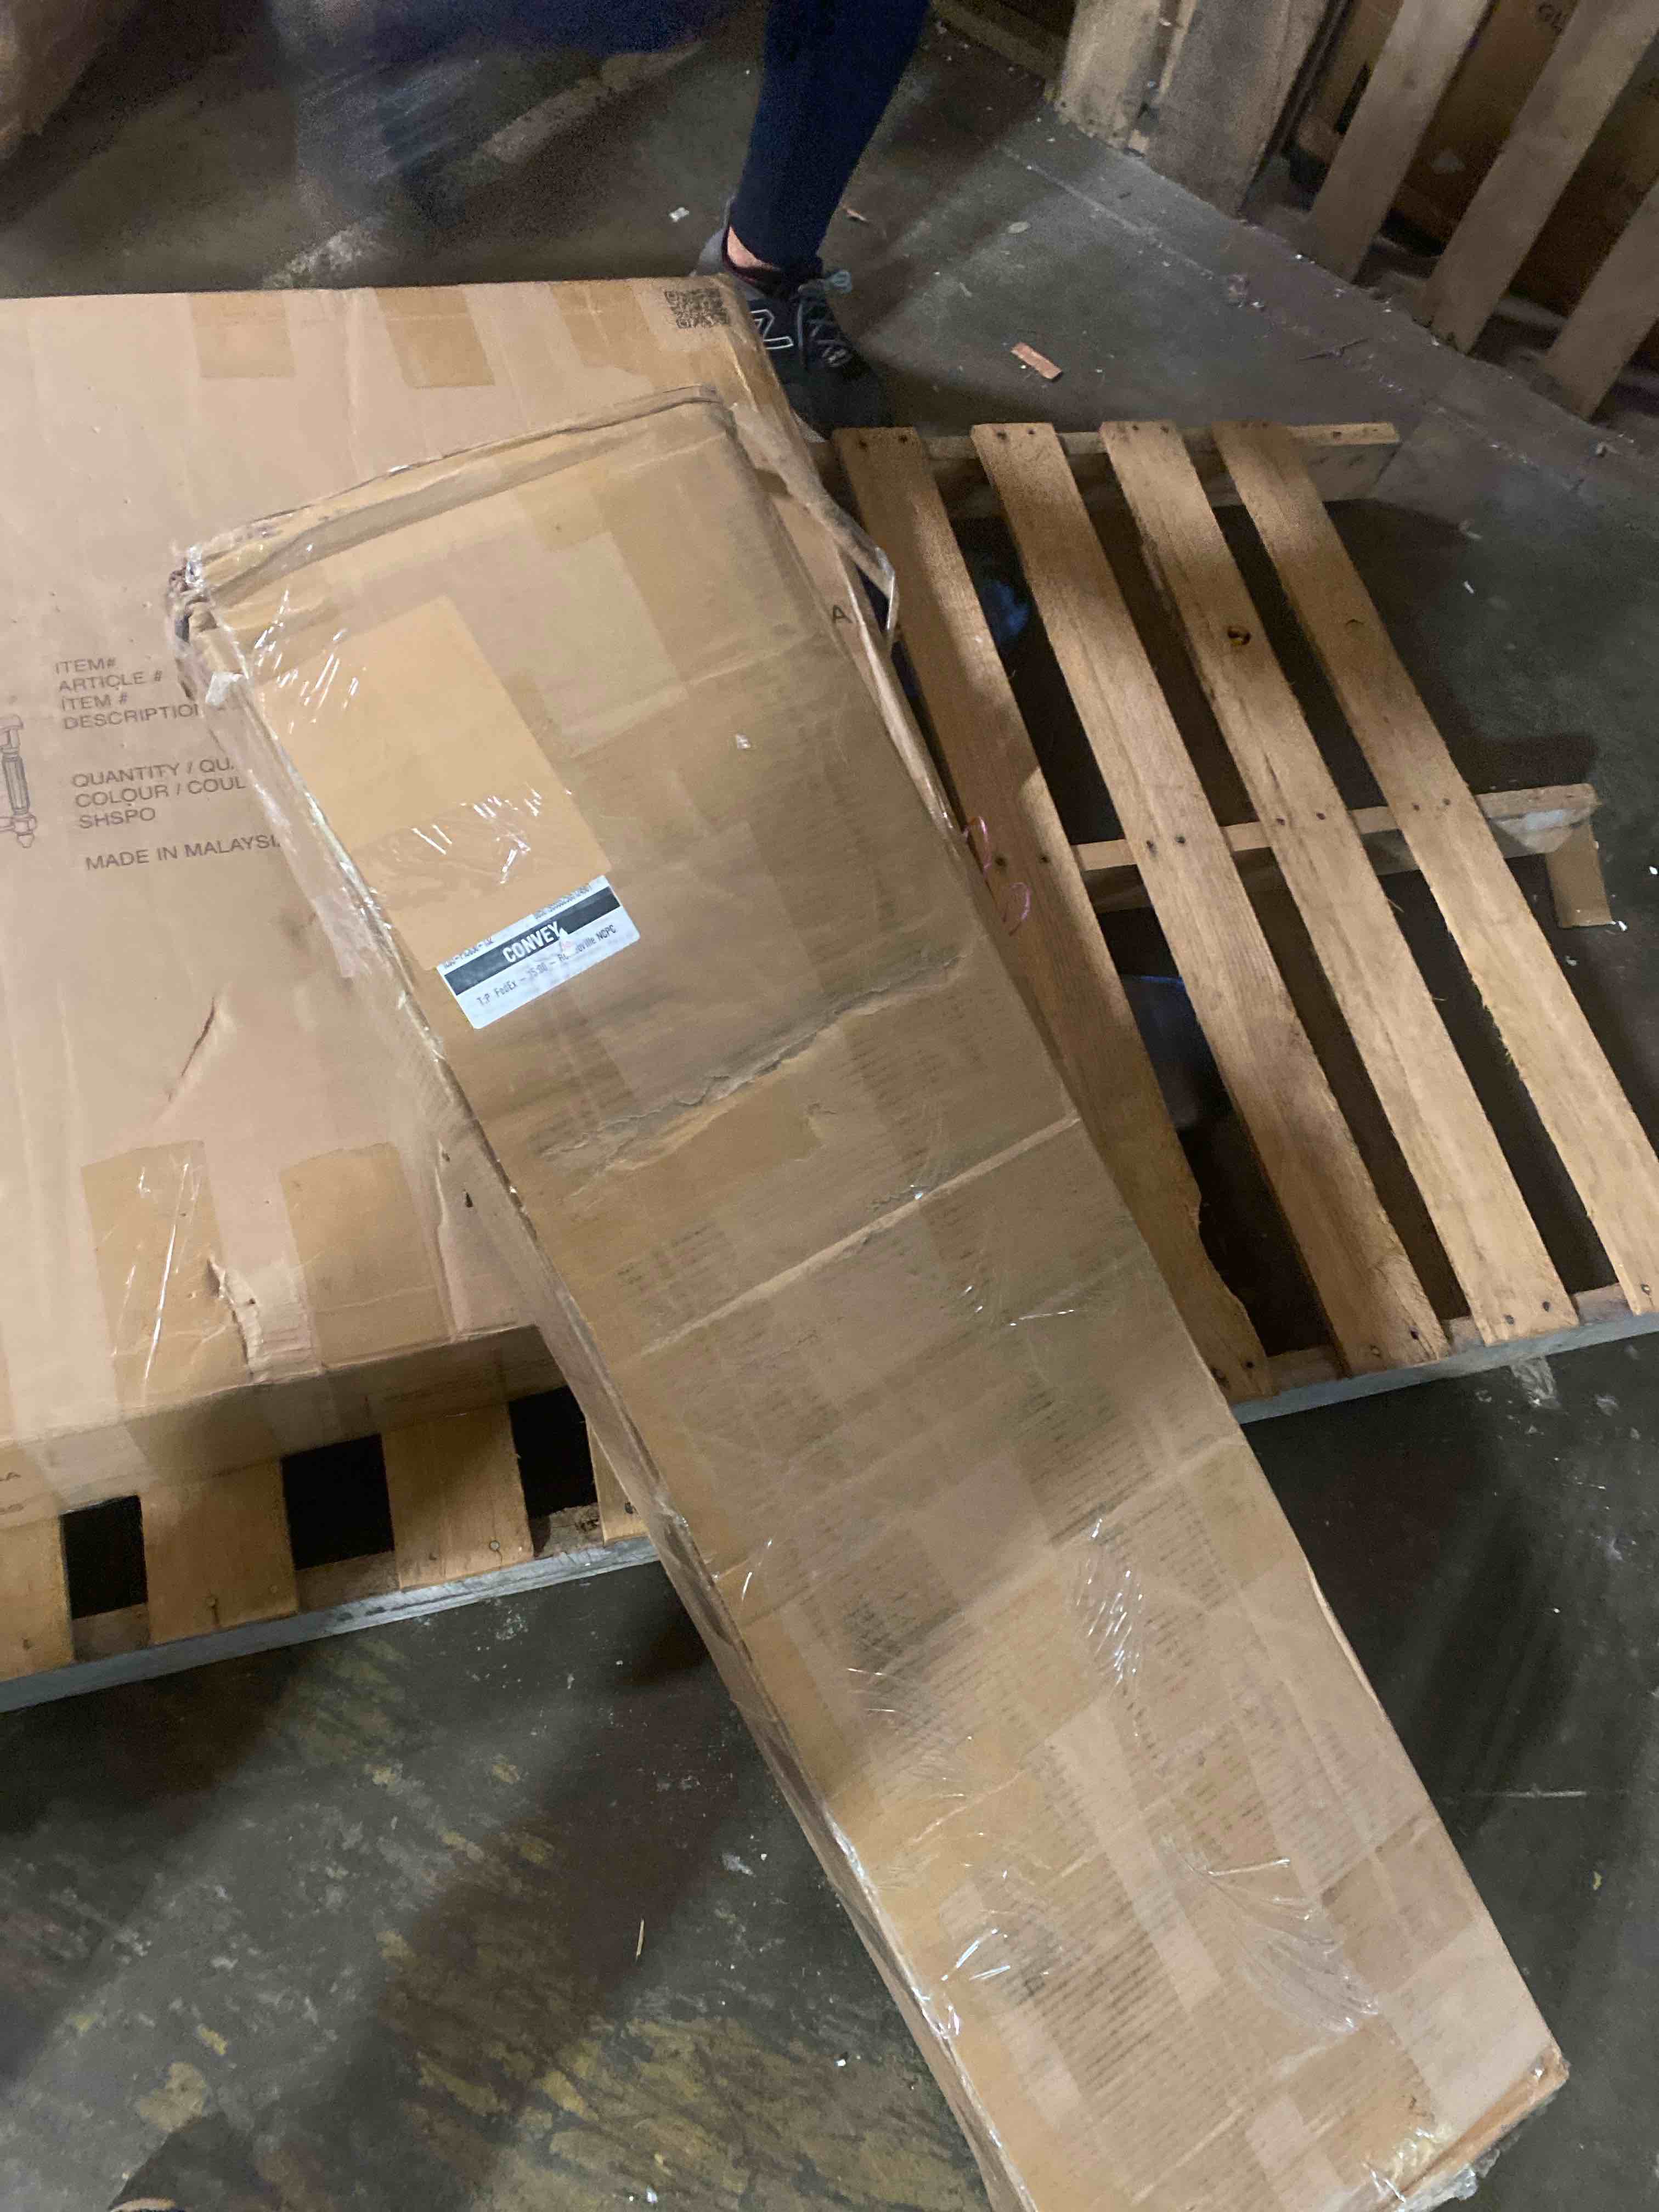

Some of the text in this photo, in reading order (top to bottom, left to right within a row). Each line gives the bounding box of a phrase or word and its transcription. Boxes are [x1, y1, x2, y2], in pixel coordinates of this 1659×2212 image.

[55, 657, 115, 674] ITEM#
[59, 670, 163, 692] ARTICLE #
[61, 692, 128, 712] ITEM #
[72, 757, 234, 788] QUANTITY / QU
[75, 785, 170, 808] COLOUR
[79, 808, 156, 829] SHSPO
[86, 834, 281, 871] MADE IN MALAYSI
[502, 921, 560, 962] CONVEY
